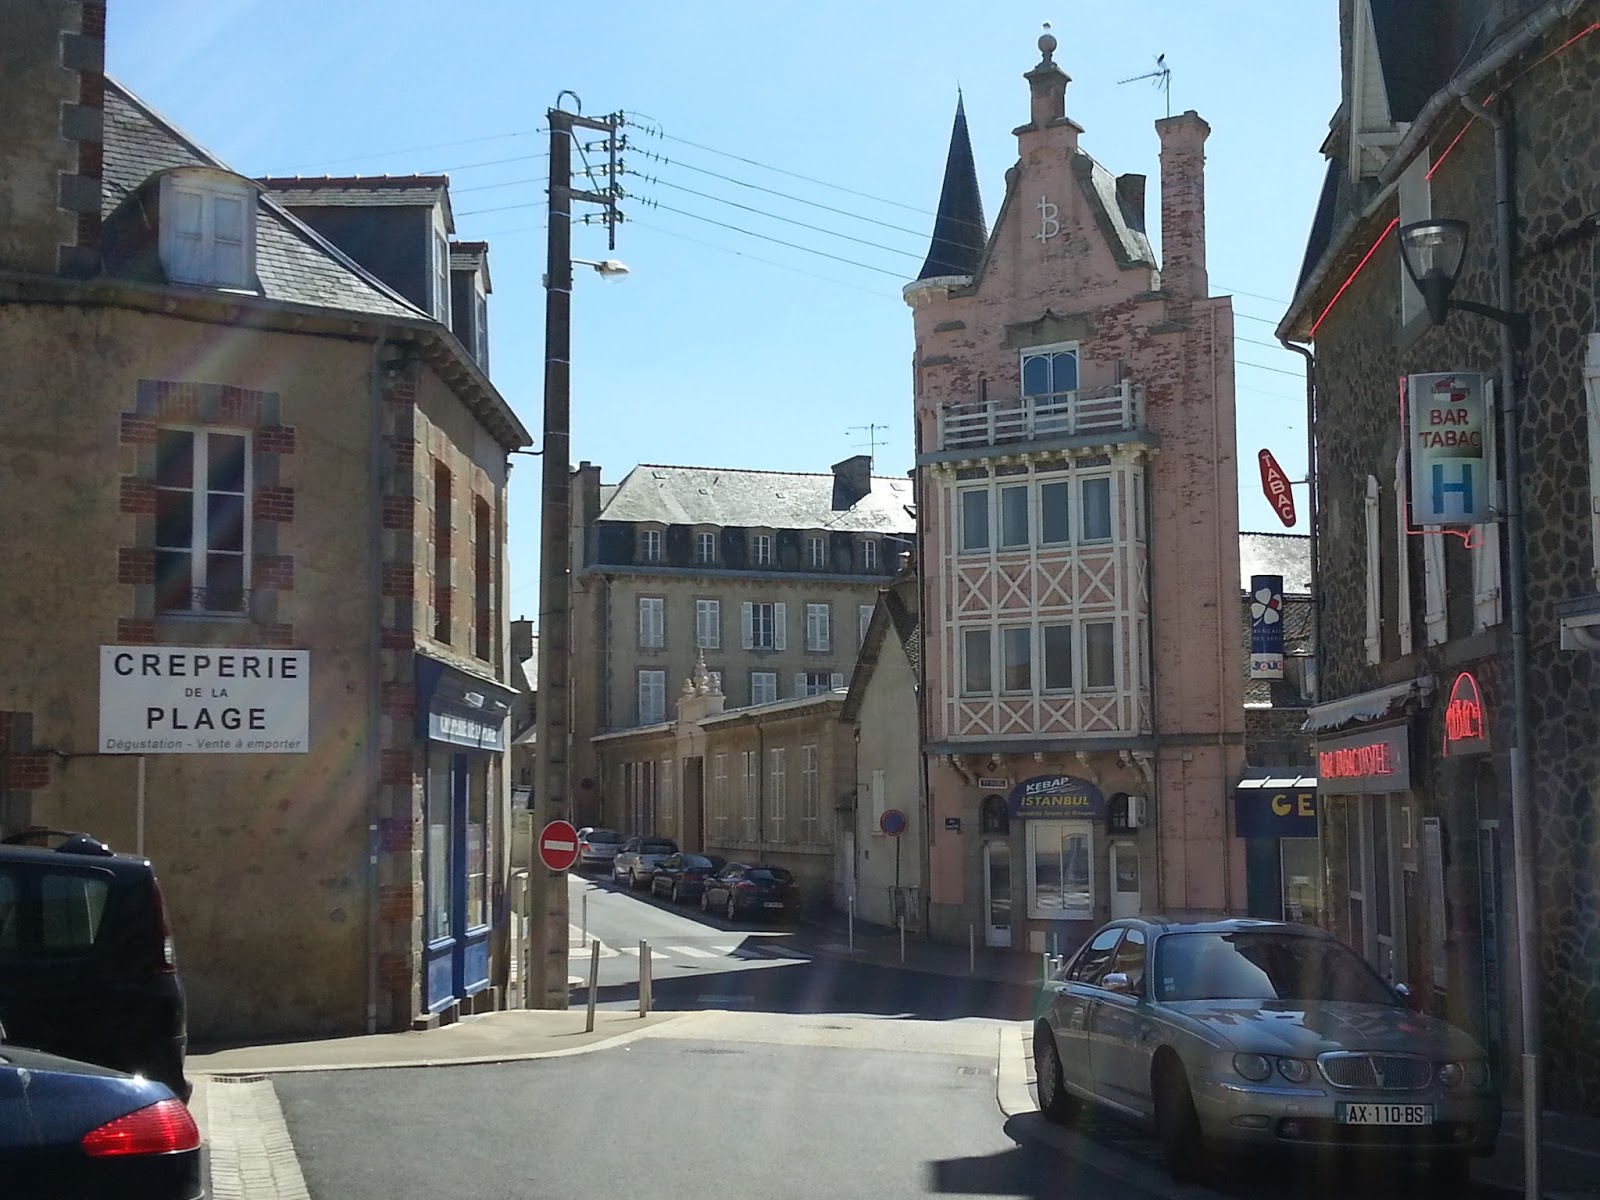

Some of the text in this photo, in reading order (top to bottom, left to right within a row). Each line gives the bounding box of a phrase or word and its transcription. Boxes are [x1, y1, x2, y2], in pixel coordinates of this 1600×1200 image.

[1430, 408, 1469, 426] BAR
[1419, 431, 1480, 449] TABAC
[1261, 453, 1293, 520] TABAC
[1432, 464, 1473, 514] H
[114, 653, 298, 679] CREPERIE
[185, 688, 228, 698] DE LA
[147, 707, 265, 730] PLAGE
[106, 738, 183, 751] Dégustation
[197, 739, 231, 749] Vente
[235, 740, 243, 749] à
[247, 740, 301, 751] emporter
[1026, 777, 1069, 792] KEBAP
[1021, 796, 1089, 806] ISTANBUL
